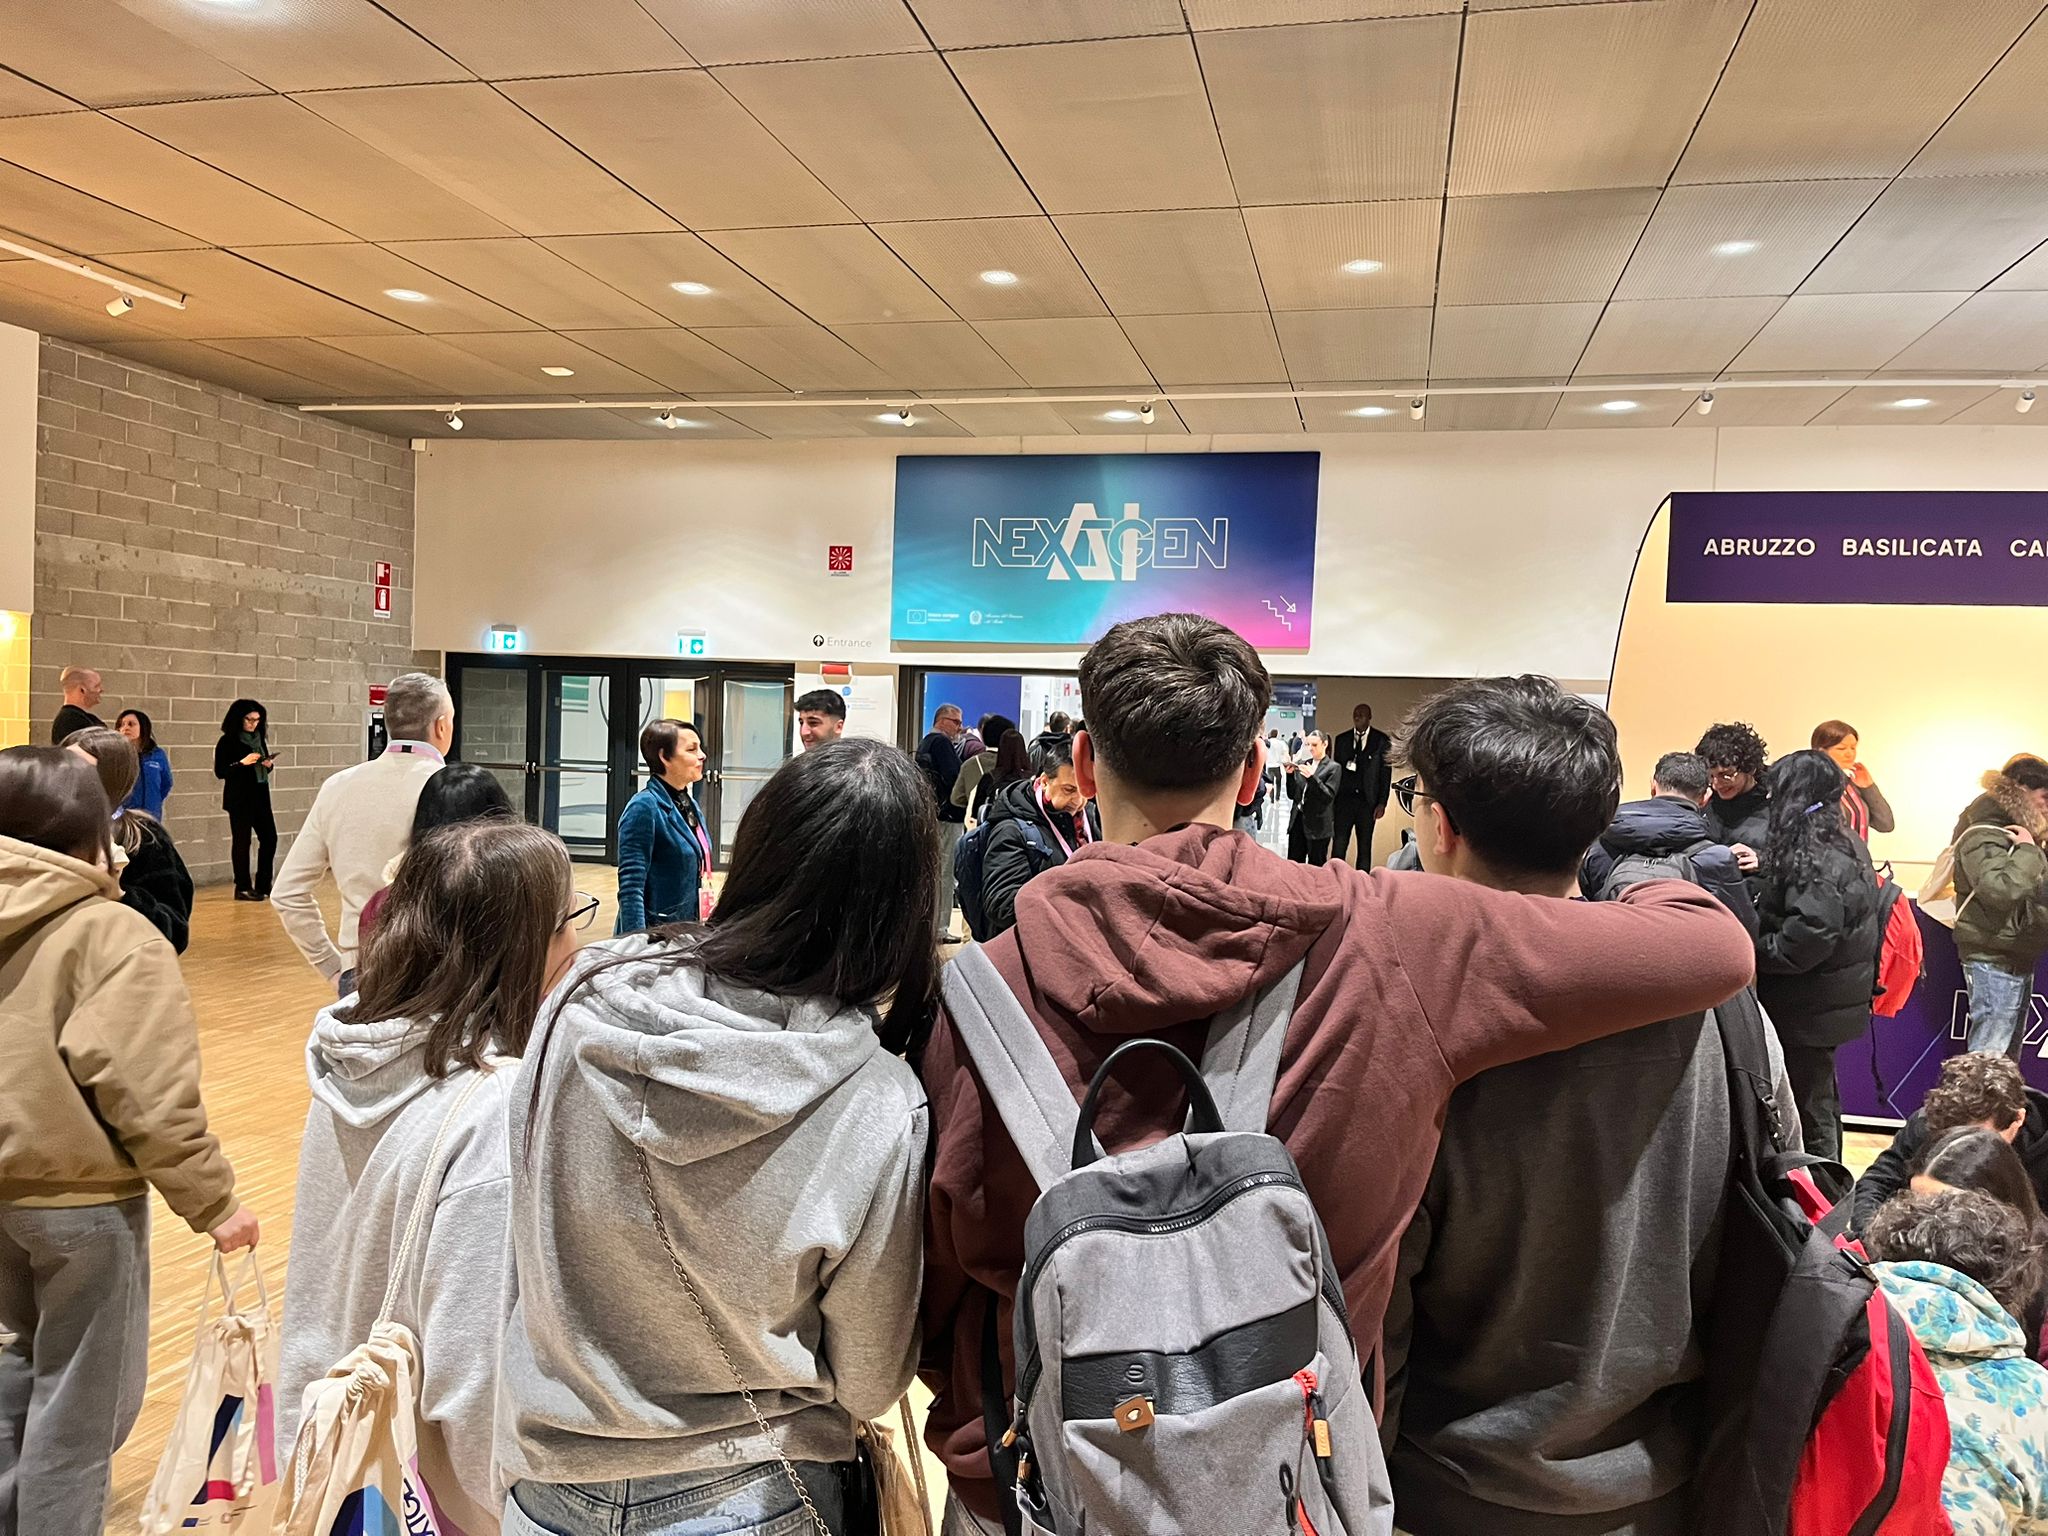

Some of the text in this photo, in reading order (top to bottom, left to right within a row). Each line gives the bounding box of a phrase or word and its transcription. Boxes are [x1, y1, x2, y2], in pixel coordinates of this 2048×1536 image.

[1703, 538, 2048, 558] ABRUZZO BASILICATA CA
[827, 636, 872, 648] Entrance
